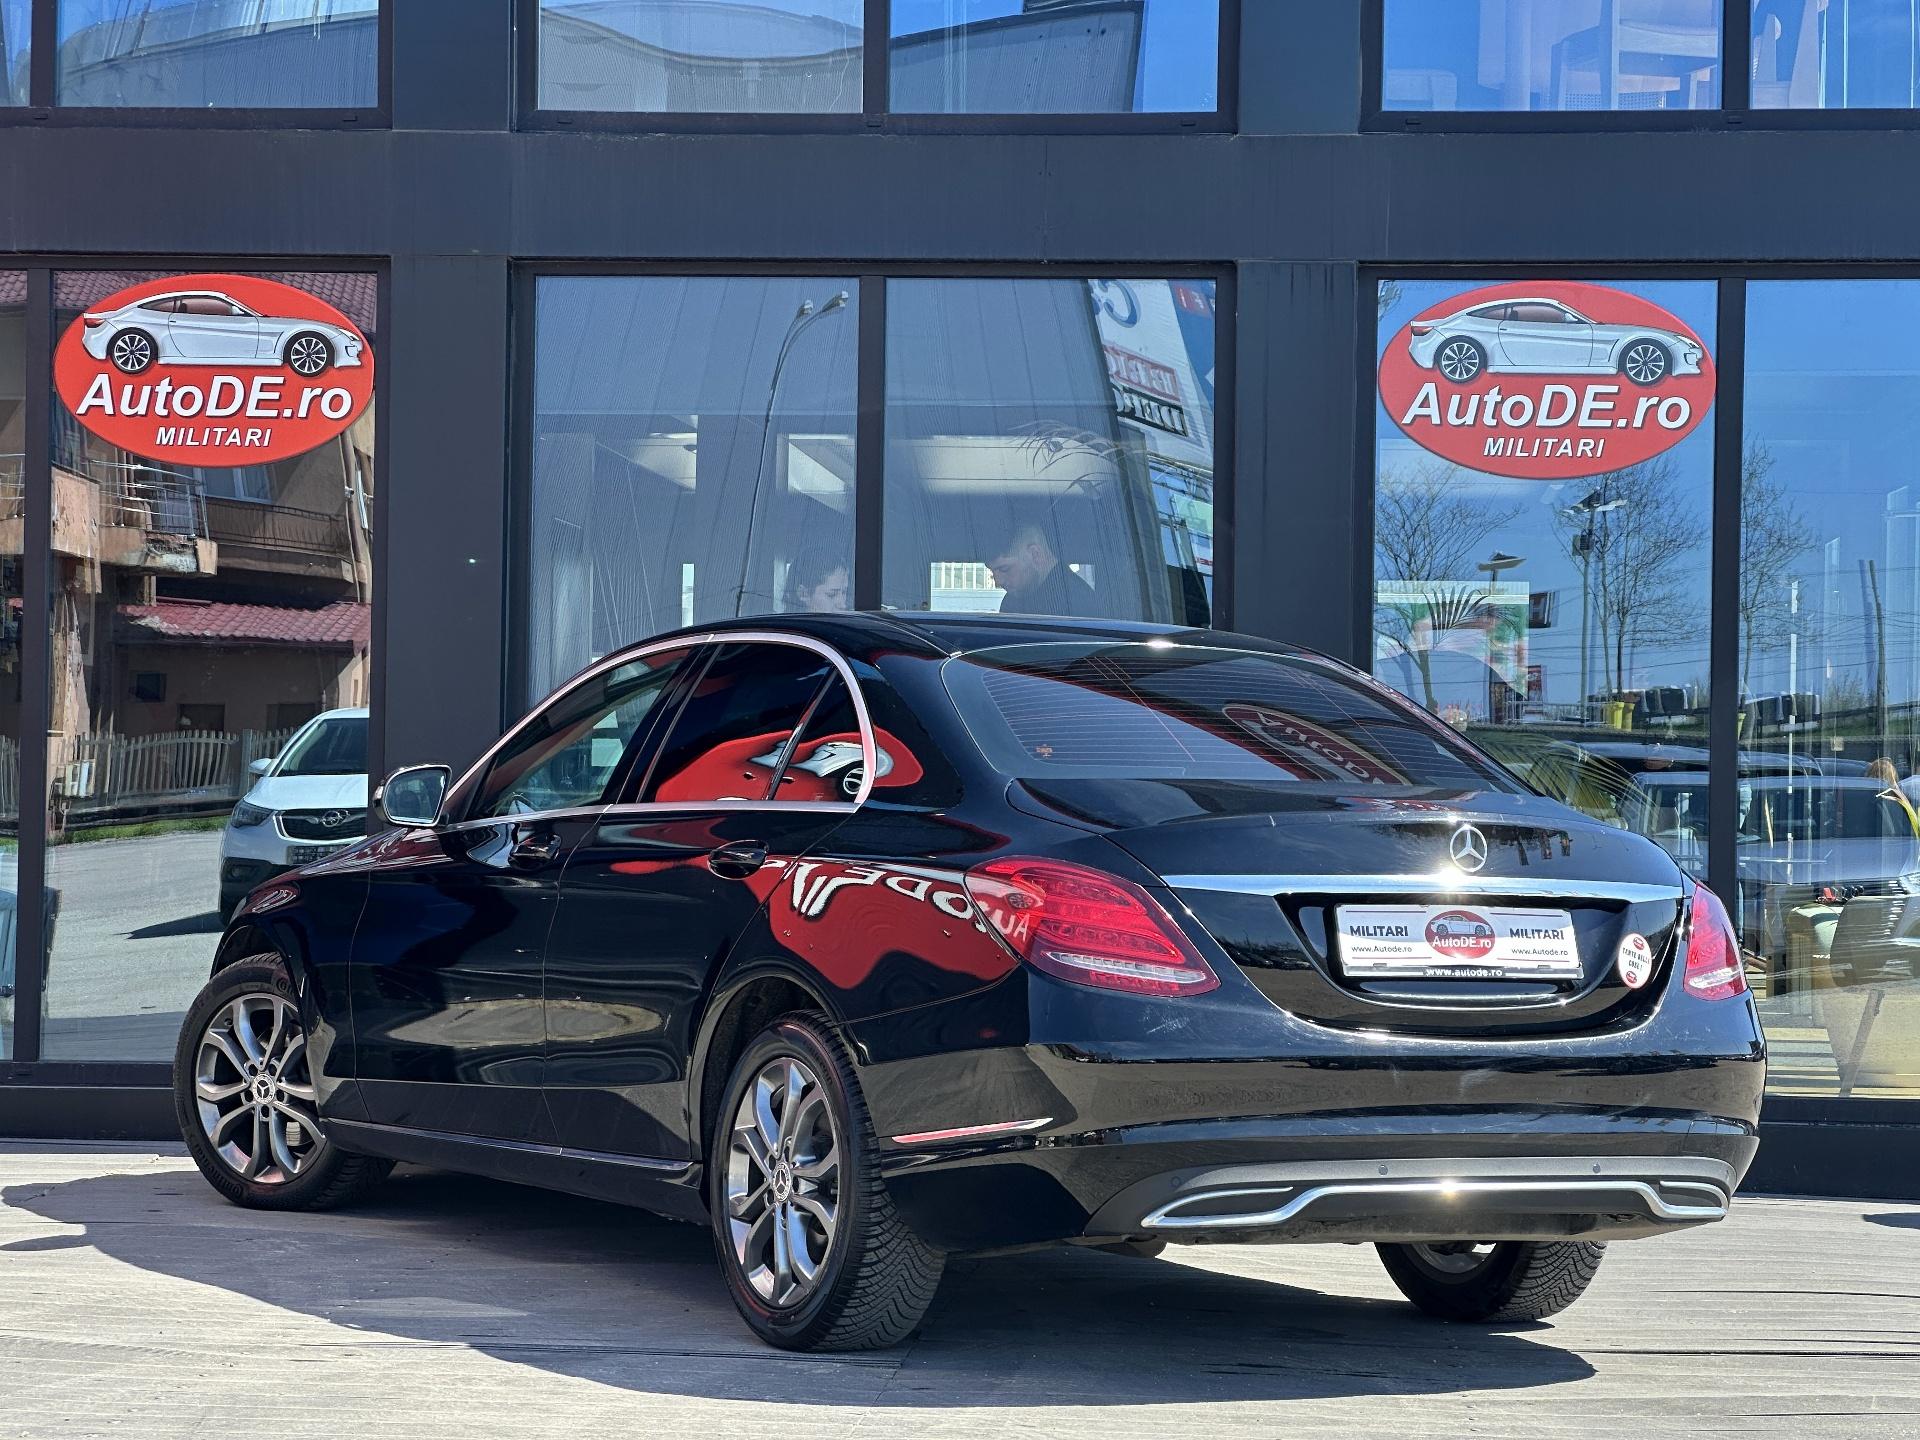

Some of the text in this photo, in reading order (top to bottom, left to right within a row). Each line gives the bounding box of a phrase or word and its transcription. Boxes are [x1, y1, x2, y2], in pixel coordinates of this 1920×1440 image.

[76, 373, 352, 419] AutoDE.ro
[1401, 382, 1691, 429] AutoDE.ro
[155, 427, 272, 447] MILITARI
[1483, 437, 1605, 458] MILITARI
[1349, 925, 1409, 937] MILITARI
[1509, 928, 1564, 940] MILITARI
[1432, 936, 1492, 949] AutoDE.ro
[1351, 945, 1412, 953] www.Autode.ro
[1511, 948, 1568, 956] www.Autode.ro
[1426, 968, 1503, 977] www.autode.ro
